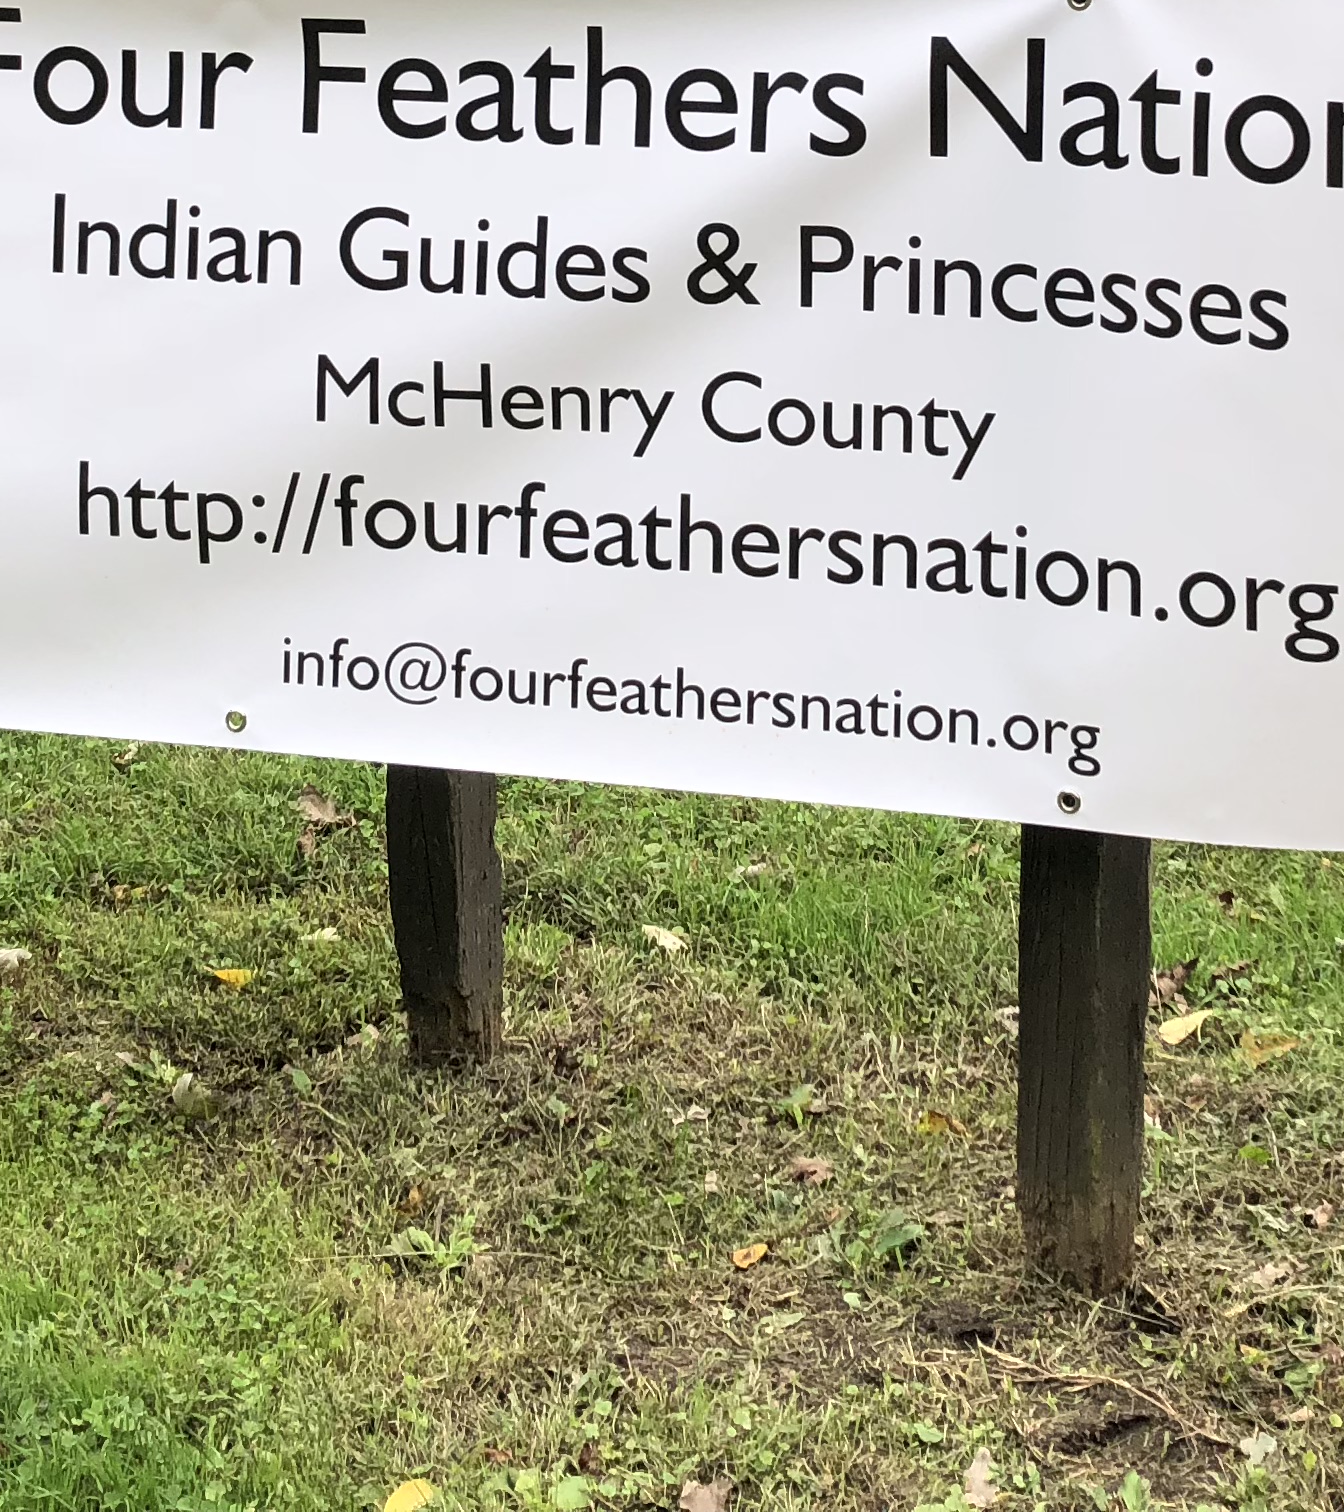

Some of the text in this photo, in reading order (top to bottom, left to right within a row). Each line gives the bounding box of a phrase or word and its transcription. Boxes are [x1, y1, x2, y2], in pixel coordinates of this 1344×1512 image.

[300, 17, 868, 158] Feathers
[52, 192, 1291, 351] Indian Guides & Princesses
[315, 354, 997, 481] McHenry County
[78, 460, 1341, 664] http://fourfeathersnation.org
[281, 637, 1102, 778] info@fourfeathersnation.org
